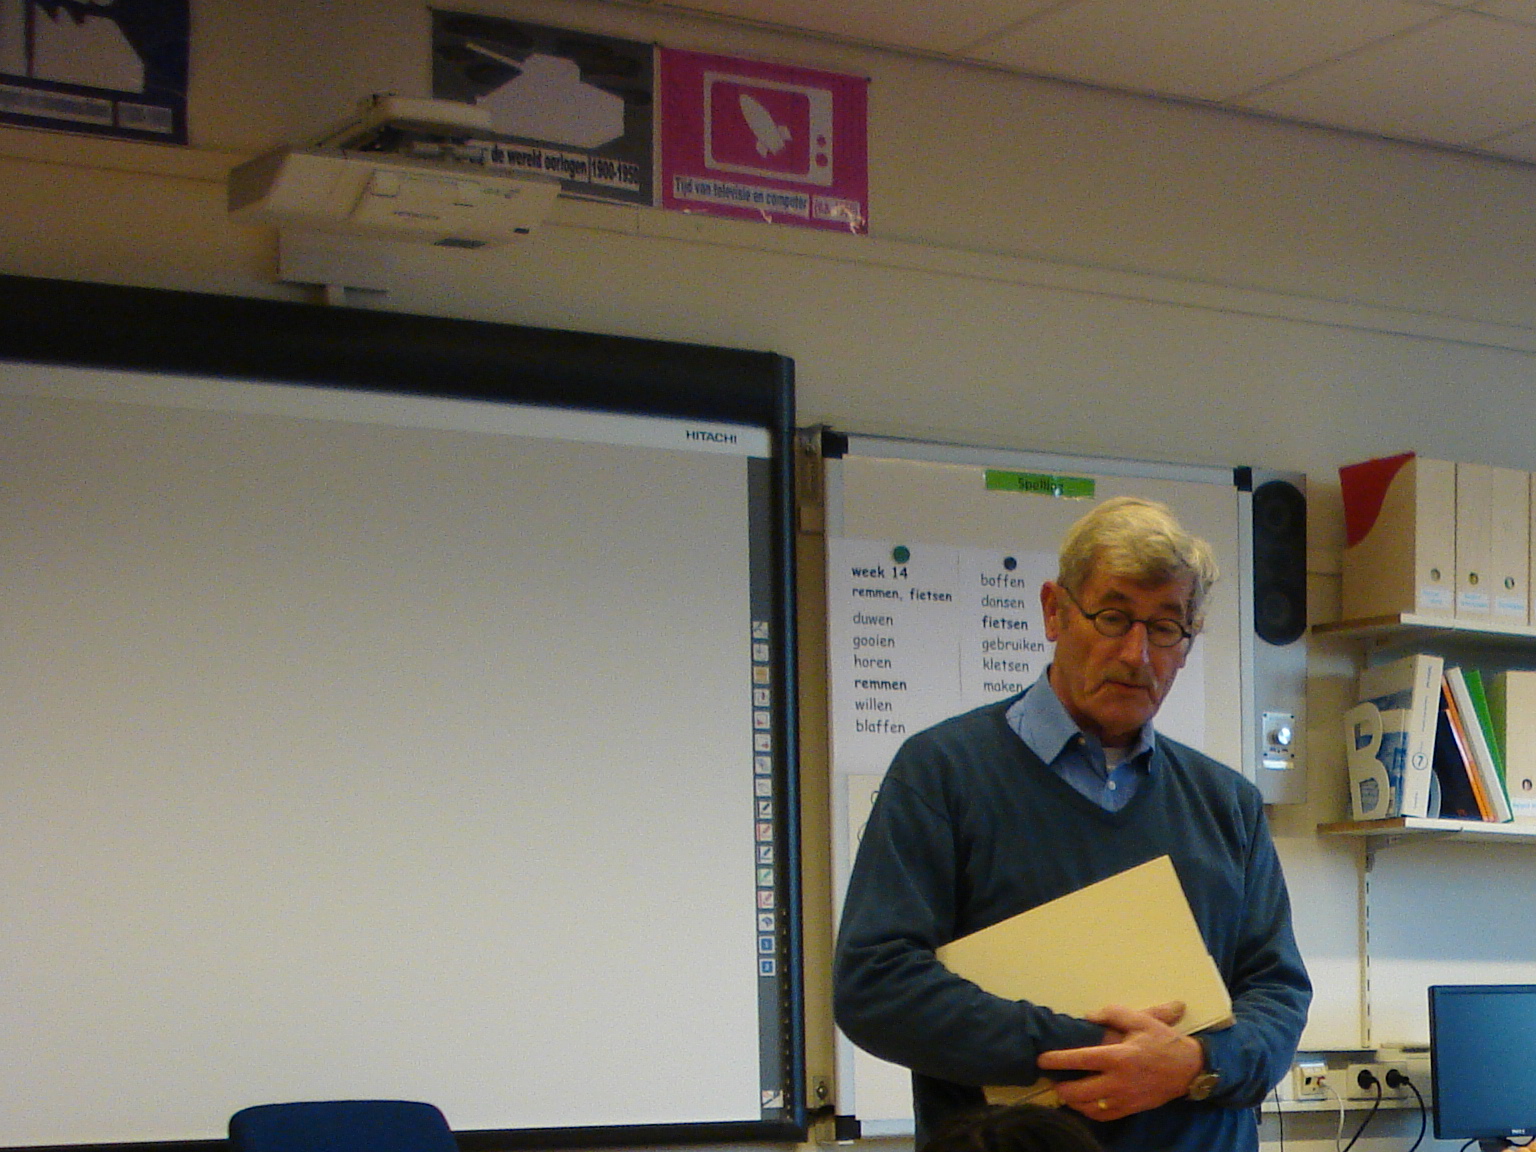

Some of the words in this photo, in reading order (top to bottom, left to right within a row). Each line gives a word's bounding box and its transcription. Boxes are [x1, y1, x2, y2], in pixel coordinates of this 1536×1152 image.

[675, 176, 692, 197] Tijd
[686, 429, 737, 444] HITACHI
[851, 565, 885, 579] week
[892, 566, 908, 580] 14
[980, 572, 1025, 588] boffen
[910, 587, 953, 602] fietsen
[981, 594, 1025, 609] dansen
[853, 612, 894, 626] duwen
[981, 615, 1028, 630] fietsen
[853, 634, 896, 650] gooien
[981, 636, 1045, 653] gebruiken
[853, 654, 892, 669] horen
[982, 656, 1029, 672] kletsen
[854, 678, 907, 691] remmen
[983, 679, 1024, 693] maken
[855, 697, 892, 712] willen
[855, 719, 906, 734] blaffen
